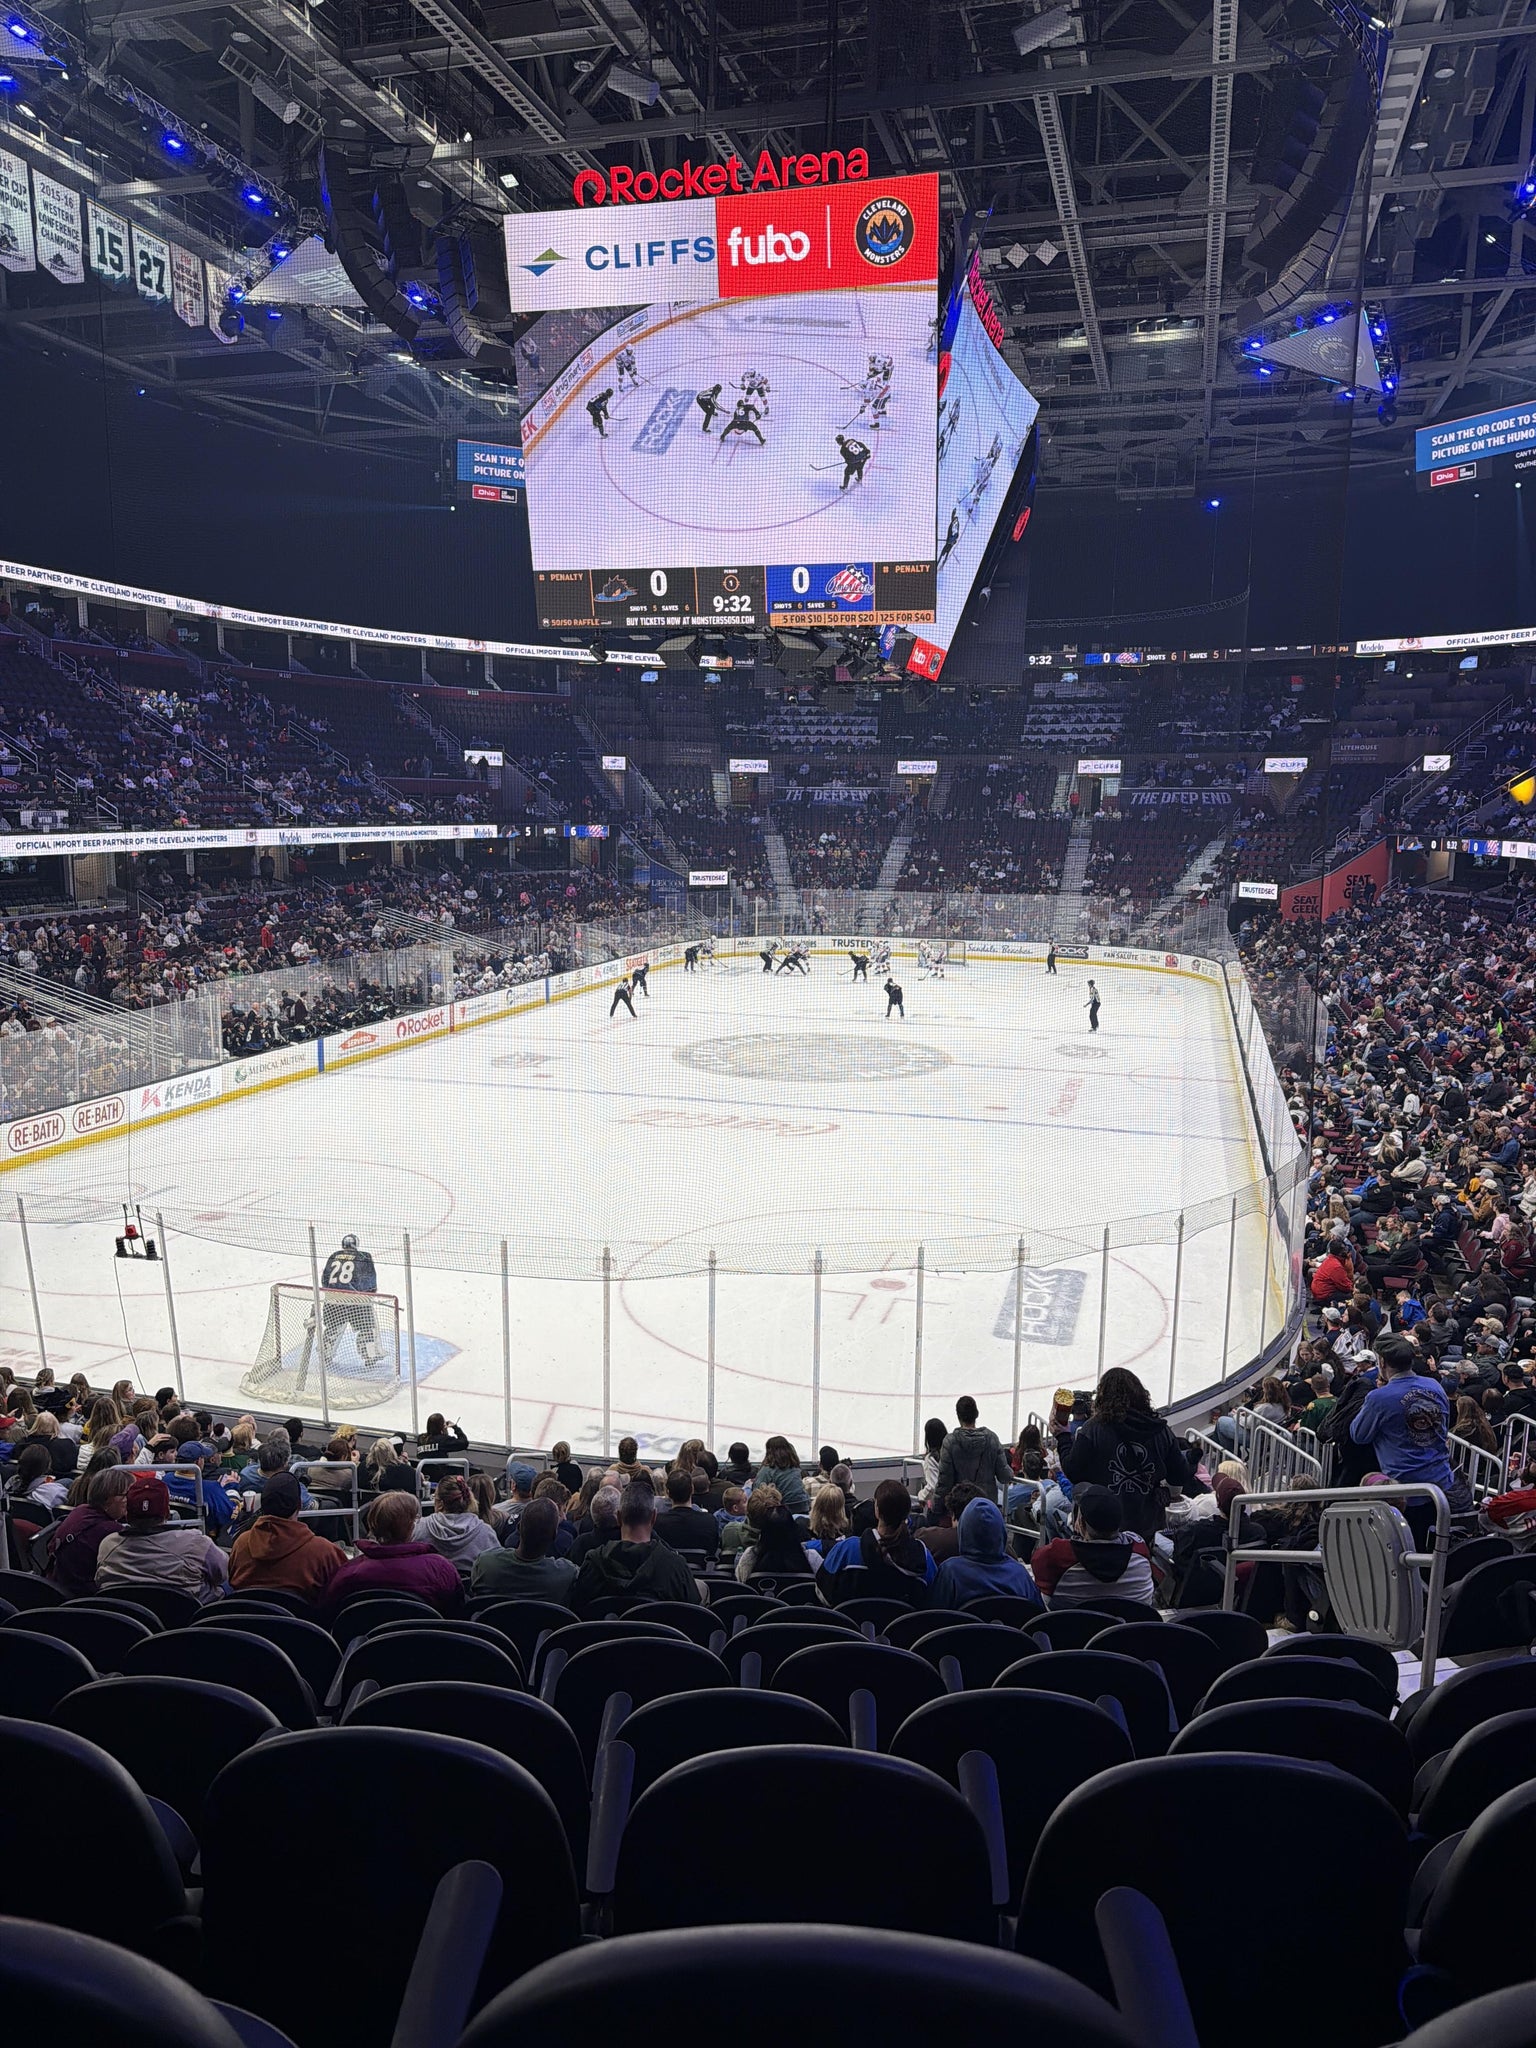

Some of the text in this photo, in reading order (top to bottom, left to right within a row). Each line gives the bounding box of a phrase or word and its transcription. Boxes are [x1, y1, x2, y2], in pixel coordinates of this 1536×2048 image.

[610, 147, 869, 204] Rocket Arena
[11, 180, 27, 196] CUP
[40, 182, 74, 209] 2015-16
[42, 198, 74, 226] WESTERN
[861, 197, 908, 221] CLEVELAND
[38, 211, 81, 242] CONFERENCE
[41, 226, 80, 255] CHAMPIONS
[727, 225, 811, 267] fubo
[96, 226, 124, 273] 15
[585, 236, 716, 271] CLIFFS
[863, 244, 907, 265] MONSTERS
[139, 250, 166, 295] 27
[1431, 414, 1530, 447] SCAN THE QR CODE TO
[1432, 427, 1536, 460] PICTURE ON THE HUMO
[474, 452, 498, 464] SCAN
[498, 456, 517, 466] THE
[474, 466, 526, 480] PICTURE ON
[1436, 472, 1454, 481] Ohio
[478, 489, 496, 497] Ohio
[895, 564, 930, 574] PENALTY
[6, 565, 167, 605] BEER PARTNER OF THE CLEVELAND MONSTERS
[550, 573, 584, 582] PENALTY
[650, 570, 668, 597] 0
[792, 566, 810, 594] 0
[175, 599, 196, 612] Modelo
[713, 595, 752, 613] 9:32
[551, 618, 572, 626] 50/50
[626, 616, 755, 626] BUY TICKETS NOW AT MONSTERS5050.COM
[783, 614, 822, 623] 5 FOR $10
[828, 613, 874, 622] 50 FOR $20
[880, 612, 932, 622] 125 FOR $40
[230, 612, 256, 623] OFFICIAL
[256, 616, 282, 626] IMPORT
[282, 620, 299, 628] BEER
[300, 622, 329, 632] PARTNER
[340, 627, 352, 635] THE
[352, 628, 390, 640] CLEVELAND
[390, 634, 427, 644] MONSTERS
[434, 638, 456, 649] Modelo
[1360, 643, 1384, 652] Modelo
[1446, 637, 1480, 646] OFFICIAL
[1482, 634, 1508, 642] IMPORT
[505, 646, 536, 654] OFFICIAL
[1028, 656, 1052, 666] 9:32
[1103, 653, 1110, 664] 0
[1170, 652, 1177, 661] 6
[1212, 650, 1220, 659] 5
[785, 789, 872, 801] TH DEEP EN
[1130, 792, 1232, 805] THE DEEP END
[279, 832, 302, 845] Modelo
[525, 826, 532, 836] 5
[570, 826, 577, 836] 6
[15, 834, 228, 850] OFFICIAL IMPORT BEER PARTNER OF THE CLEVELAND MONSTERS
[1430, 840, 1436, 850] 0
[1474, 842, 1478, 852] 0
[651, 878, 685, 888] LECOM
[1346, 874, 1372, 886] SEAT
[1242, 886, 1276, 896] TRUSTEDSEC
[1293, 895, 1318, 905] SEAT
[1292, 904, 1320, 914] GEEK
[1116, 952, 1138, 960] SALUTE
[407, 1009, 444, 1036] Rocket
[248, 1058, 278, 1076] MEDICAL
[164, 1075, 212, 1101] KENDA
[78, 1101, 120, 1129] RE-BATH
[12, 1120, 60, 1148] RE-BATH
[328, 1261, 354, 1284] 28
